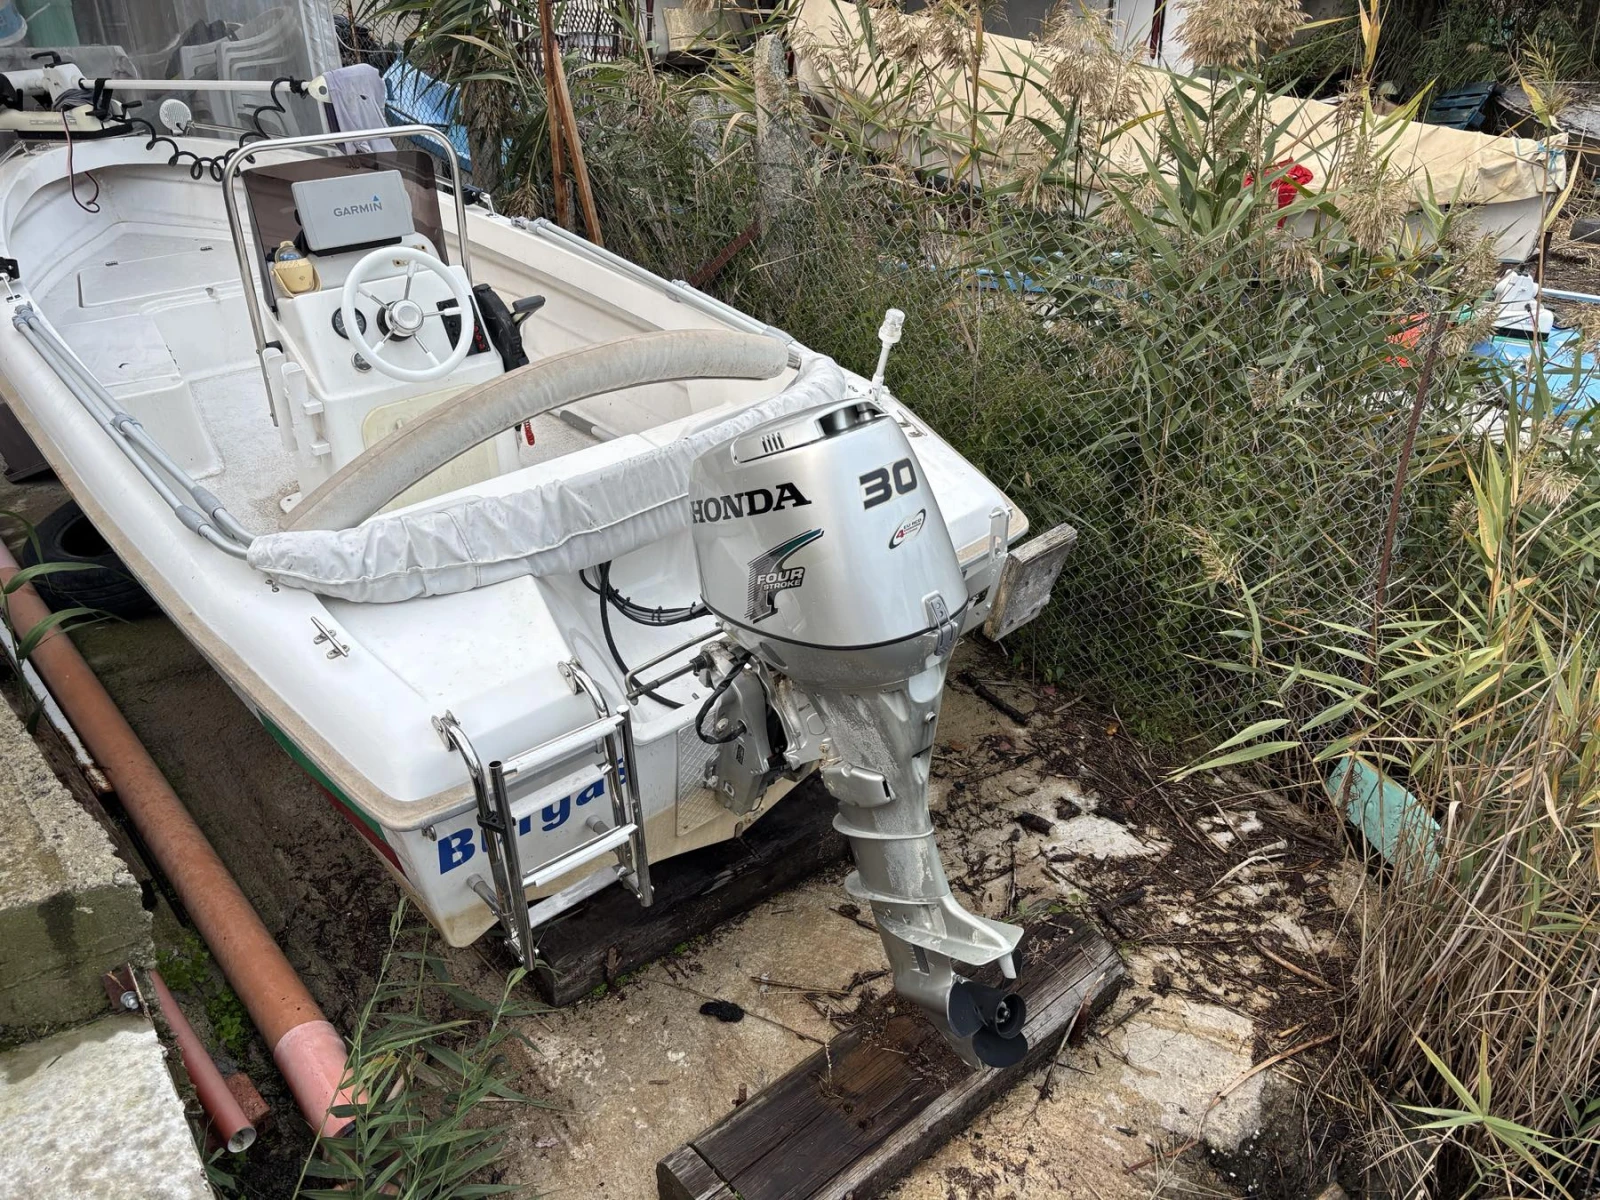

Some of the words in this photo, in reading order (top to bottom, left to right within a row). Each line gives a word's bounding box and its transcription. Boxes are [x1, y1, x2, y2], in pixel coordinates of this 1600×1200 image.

[333, 202, 383, 217] GARMIN
[859, 457, 918, 511] 30
[690, 482, 812, 524] HONDA
[756, 568, 804, 585] FOUR
[763, 578, 802, 591] STROKE
